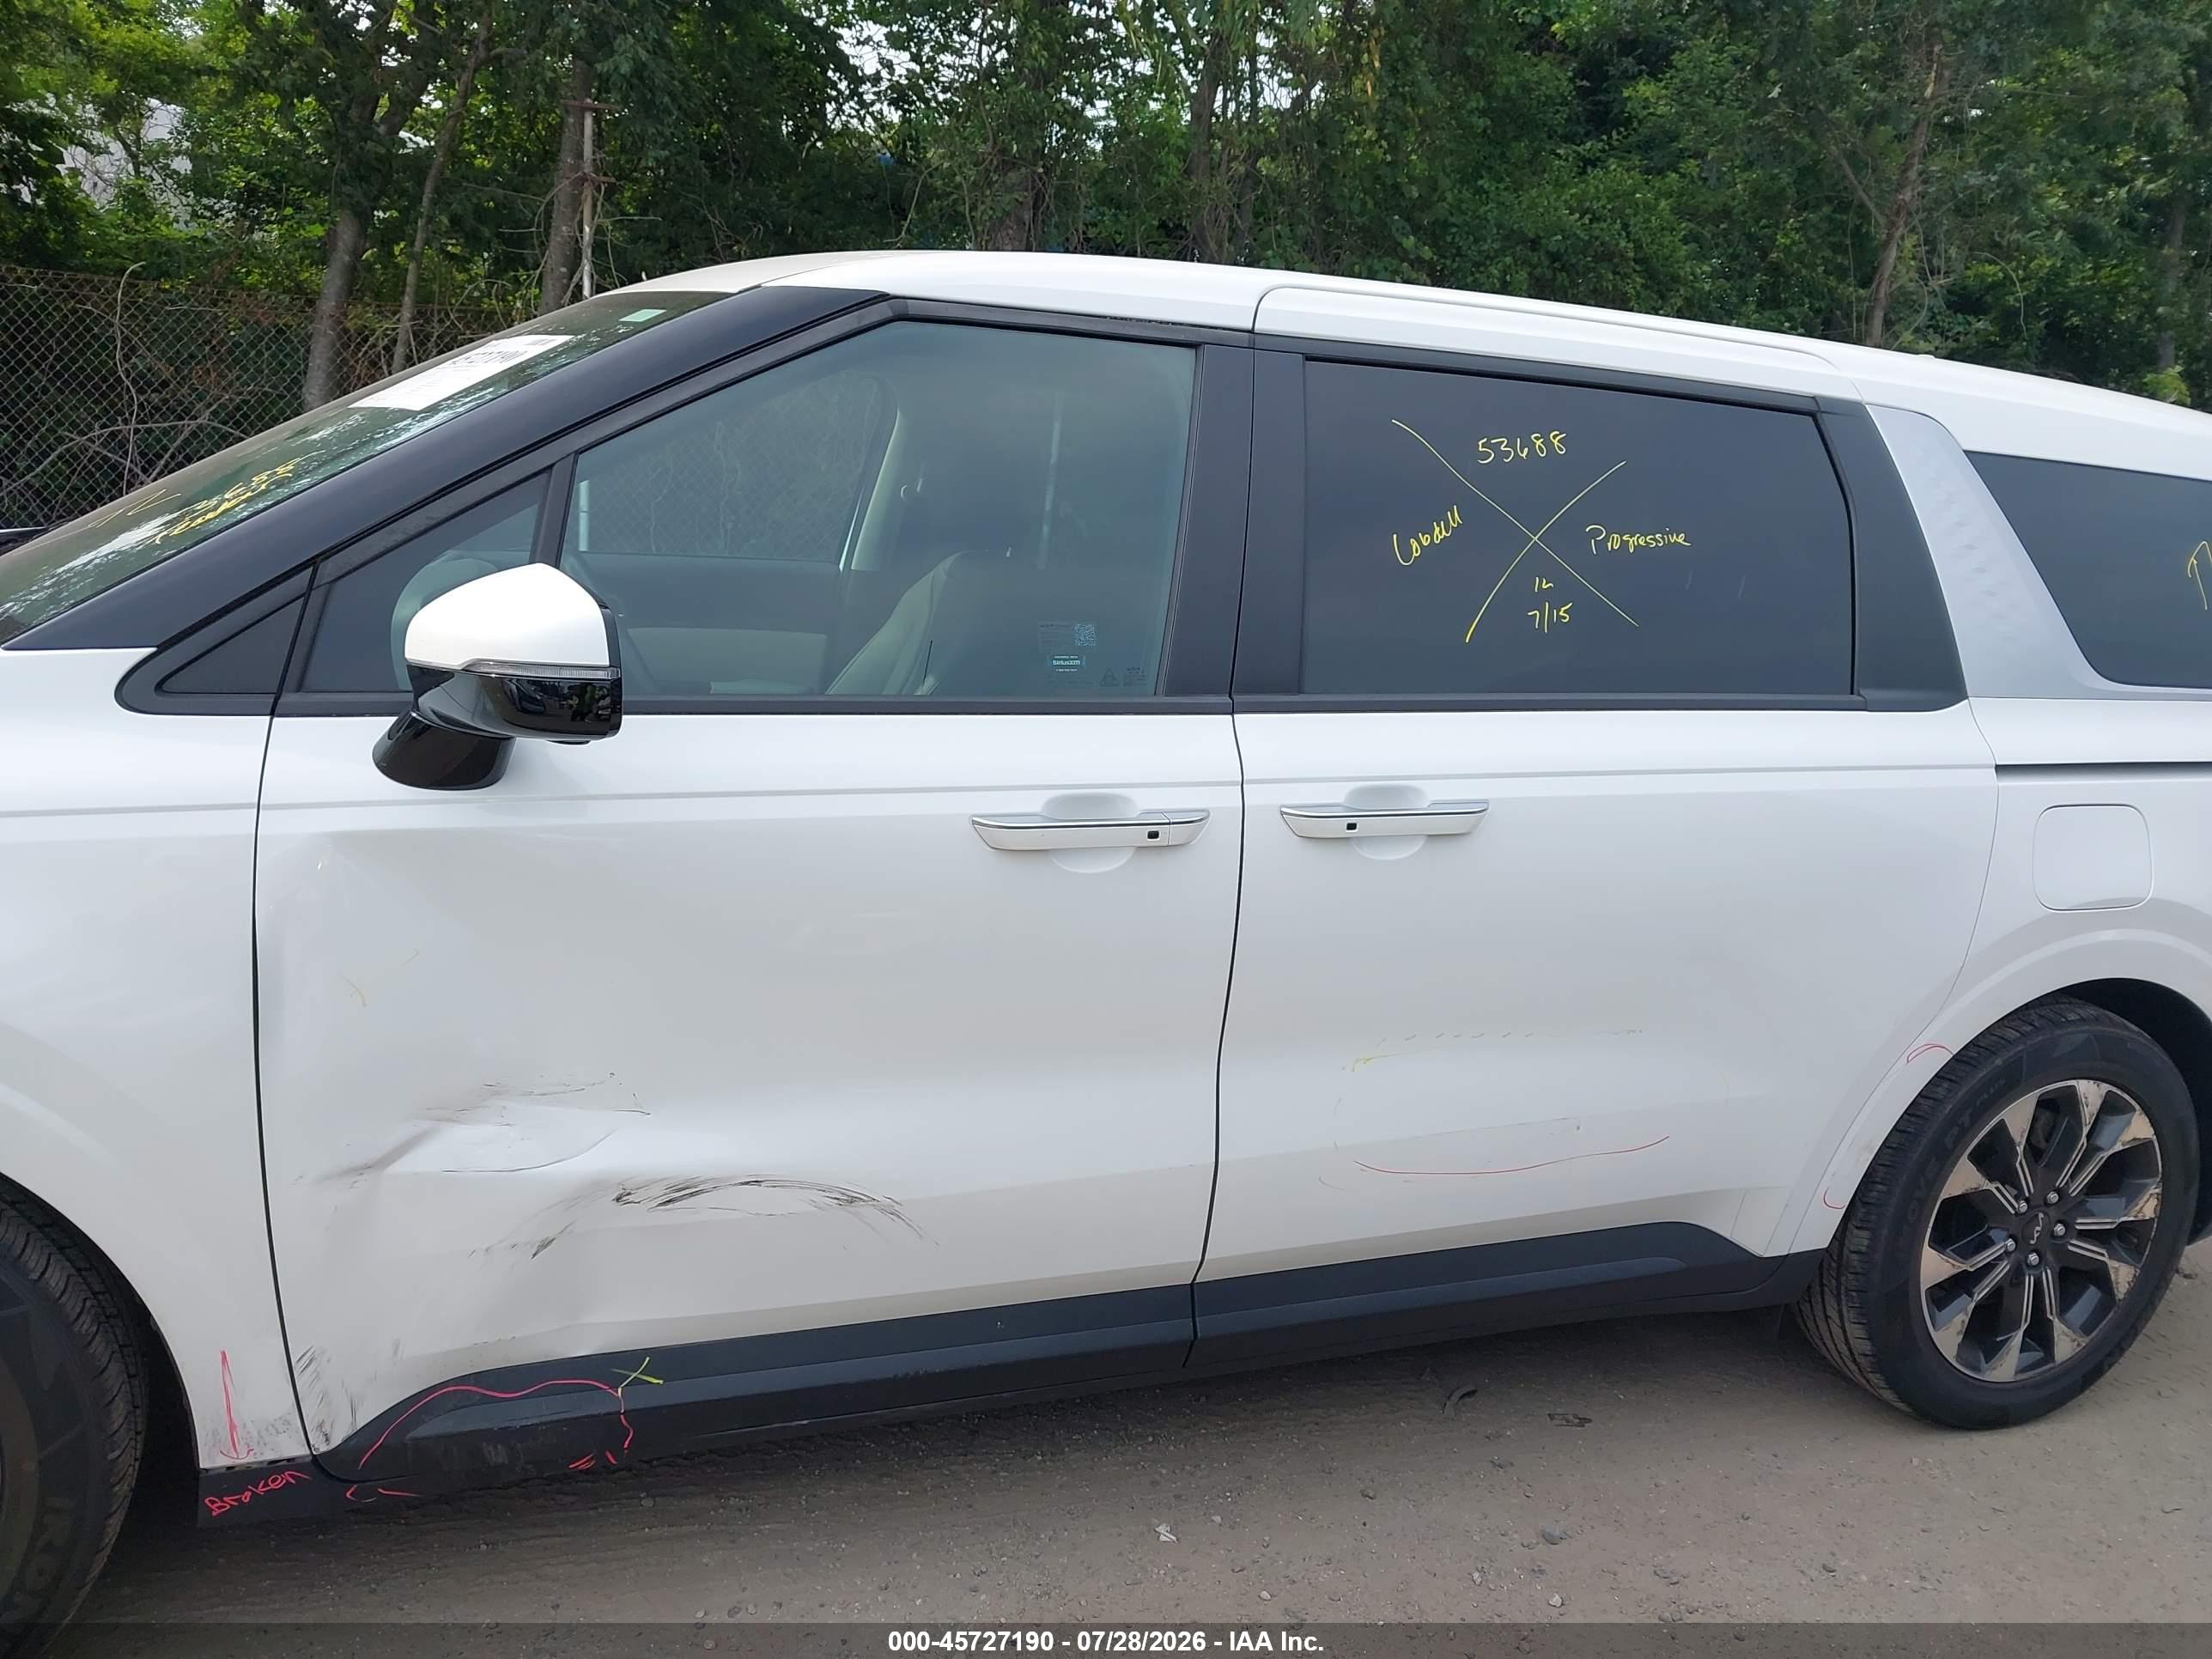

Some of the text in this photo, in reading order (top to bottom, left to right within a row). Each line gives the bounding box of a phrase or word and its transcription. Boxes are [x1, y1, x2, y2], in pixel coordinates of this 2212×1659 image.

[1477, 431, 1567, 464] 53688
[1585, 525, 1692, 555] Progressive
[1527, 601, 1573, 634] 7/15
[204, 1469, 313, 1517] Broken
